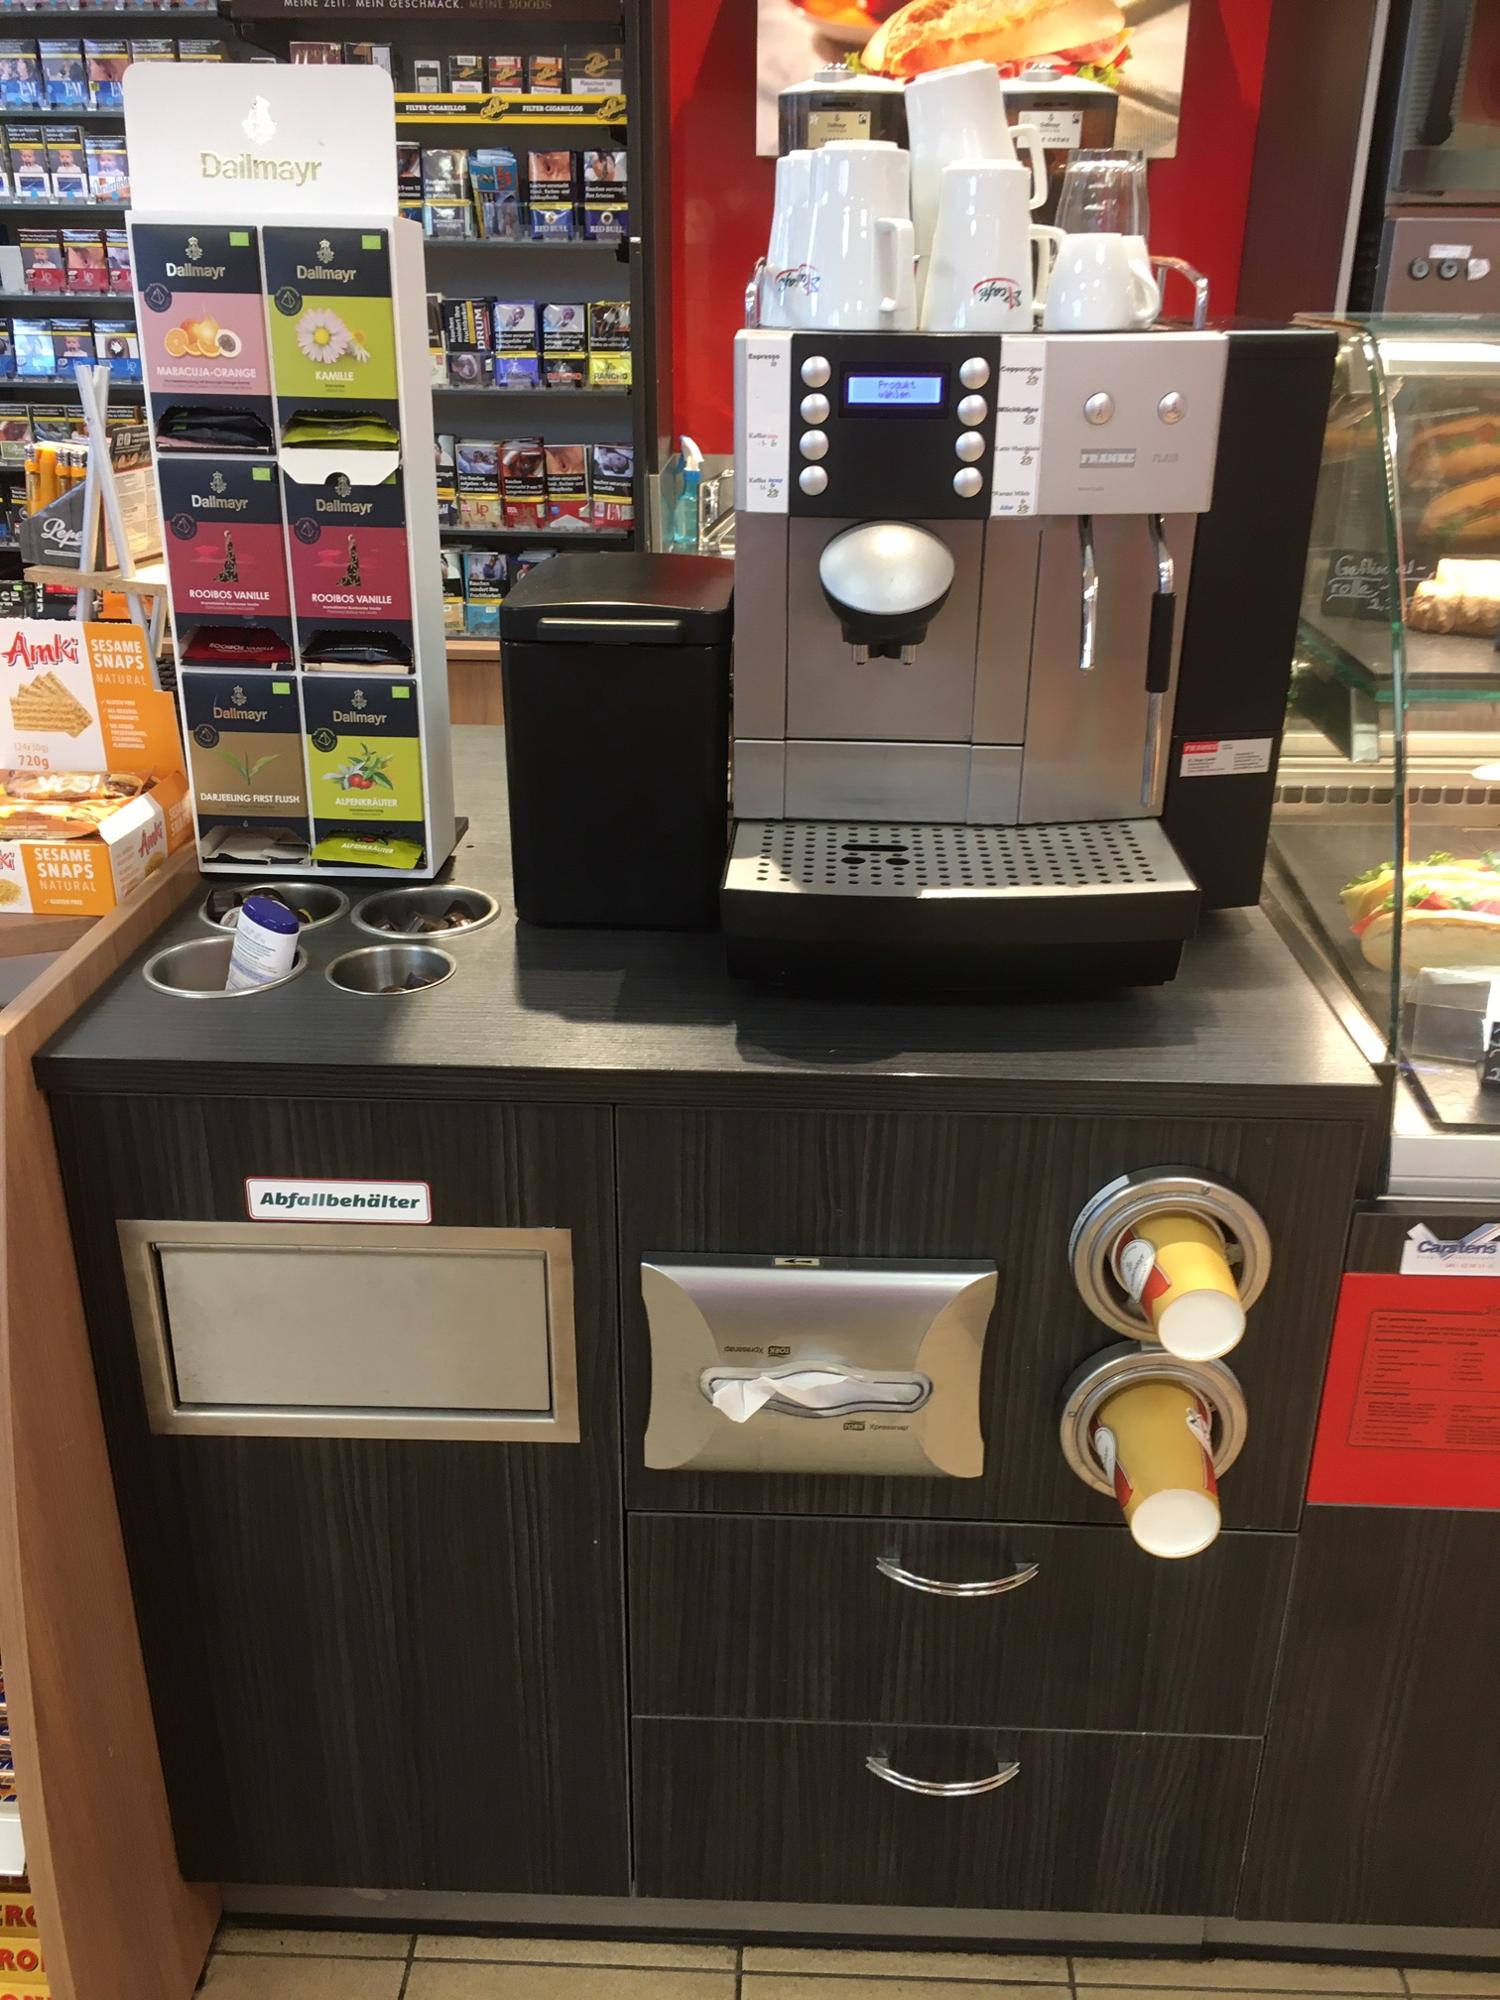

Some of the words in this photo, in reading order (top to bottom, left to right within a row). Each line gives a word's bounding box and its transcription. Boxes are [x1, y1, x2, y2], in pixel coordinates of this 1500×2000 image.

[405, 104, 427, 112] FILTER
[428, 104, 467, 112] CIGARILLOS
[200, 152, 322, 187] Dallmayr
[550, 225, 568, 233] BULL
[166, 262, 225, 280] Dallmayr
[296, 265, 356, 283] Dallmayr
[475, 307, 486, 350] DRUM
[156, 366, 257, 379] MARACUJA-ORANGE
[315, 371, 354, 381] KAMILLE
[877, 379, 916, 390] Produkt
[1081, 453, 1136, 464] FRANKE
[191, 494, 248, 512] Dallmayr
[316, 498, 373, 515] Dallmayr
[189, 589, 232, 599] ROOIBOS
[233, 590, 270, 600] VANILLE
[311, 593, 354, 603] ROOIBOS
[355, 594, 392, 604] VANILLE
[90, 638, 141, 654] SESAME
[93, 653, 144, 670] SNAPS
[95, 673, 147, 686] NATURAL
[213, 707, 267, 722] Dallmayr
[333, 711, 387, 726] Dallmayr
[18, 754, 49, 770] 720g
[200, 792, 251, 803] DARJEELING
[253, 794, 274, 803] FIRST
[275, 794, 300, 804] FLUSH
[335, 797, 398, 808] ALPENKRÄUTER
[33, 847, 92, 862] SESAME
[37, 863, 95, 879] SNAPS
[39, 880, 96, 892] NATURAL
[260, 1192, 420, 1209] Abfallbehälter
[1417, 1239, 1498, 1255] Carstens
